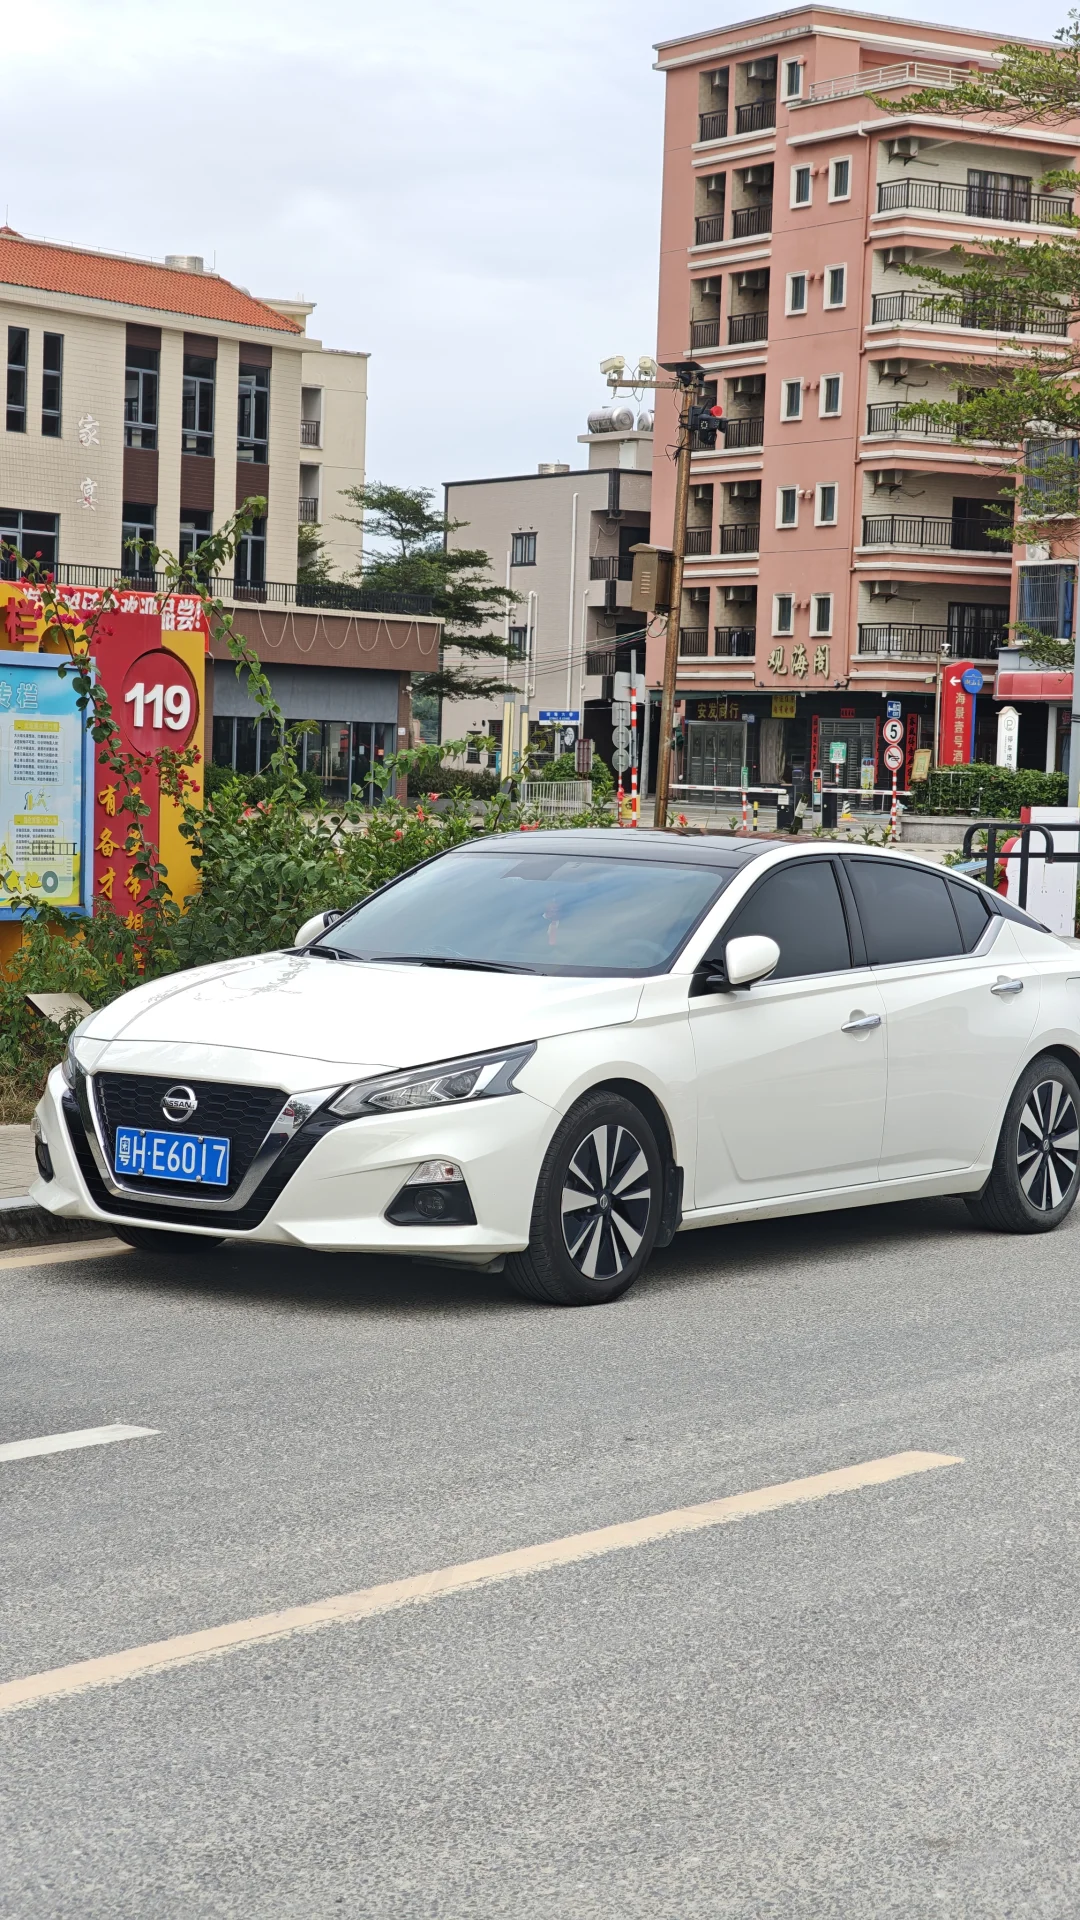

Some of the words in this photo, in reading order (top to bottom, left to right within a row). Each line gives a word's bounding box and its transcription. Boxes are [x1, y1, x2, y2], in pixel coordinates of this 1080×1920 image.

[76, 413, 100, 511] 家宴
[4, 597, 39, 644] 栏
[768, 643, 830, 679] 观海阁
[125, 682, 191, 731] 119
[697, 702, 739, 720] 安发商行
[889, 723, 898, 740] 5
[161, 1097, 193, 1109] NISSAN
